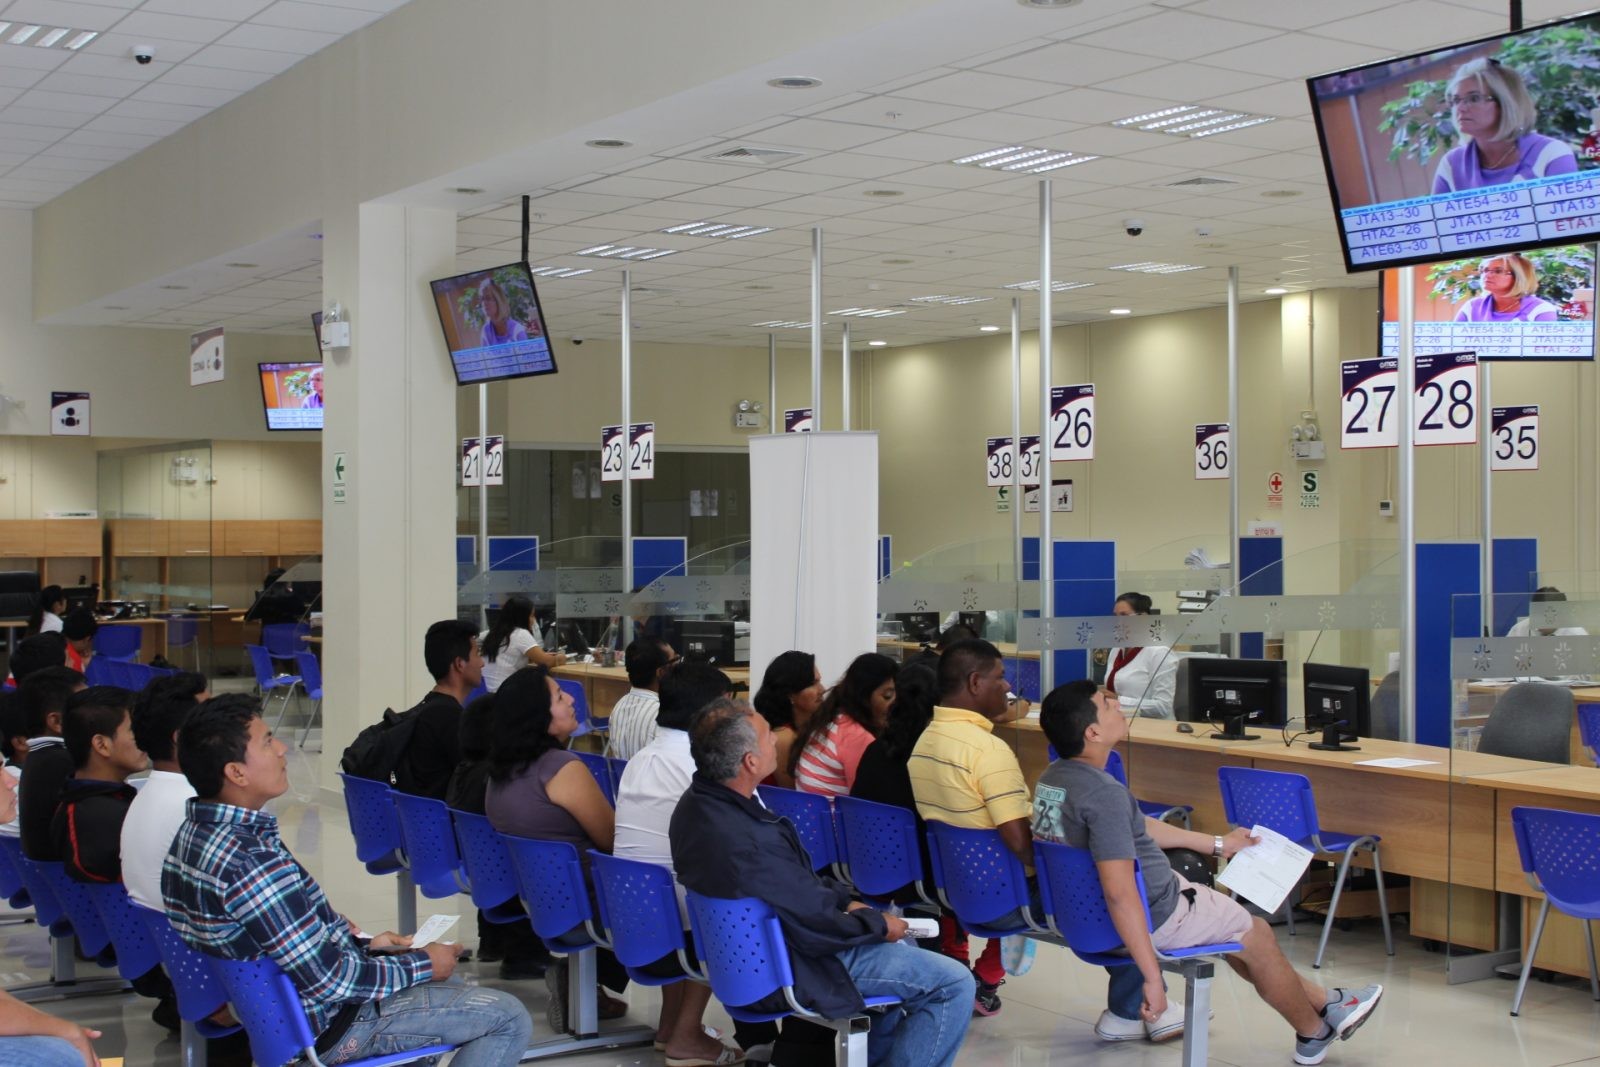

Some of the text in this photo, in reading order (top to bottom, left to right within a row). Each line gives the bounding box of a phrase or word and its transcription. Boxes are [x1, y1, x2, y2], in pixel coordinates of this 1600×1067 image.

[1345, 386, 1396, 434] 27
[1418, 380, 1473, 430] 28
[1054, 408, 1092, 448] 26
[603, 443, 622, 472] 23
[631, 441, 652, 470] 24
[1198, 440, 1228, 470] 36
[1495, 426, 1536, 460] 35
[464, 453, 479, 478] 21
[486, 451, 502, 477] 22
[990, 452, 1012, 478] 38
[1022, 450, 1040, 477] 37
[1304, 472, 1317, 492] S
[612, 494, 622, 506] S
